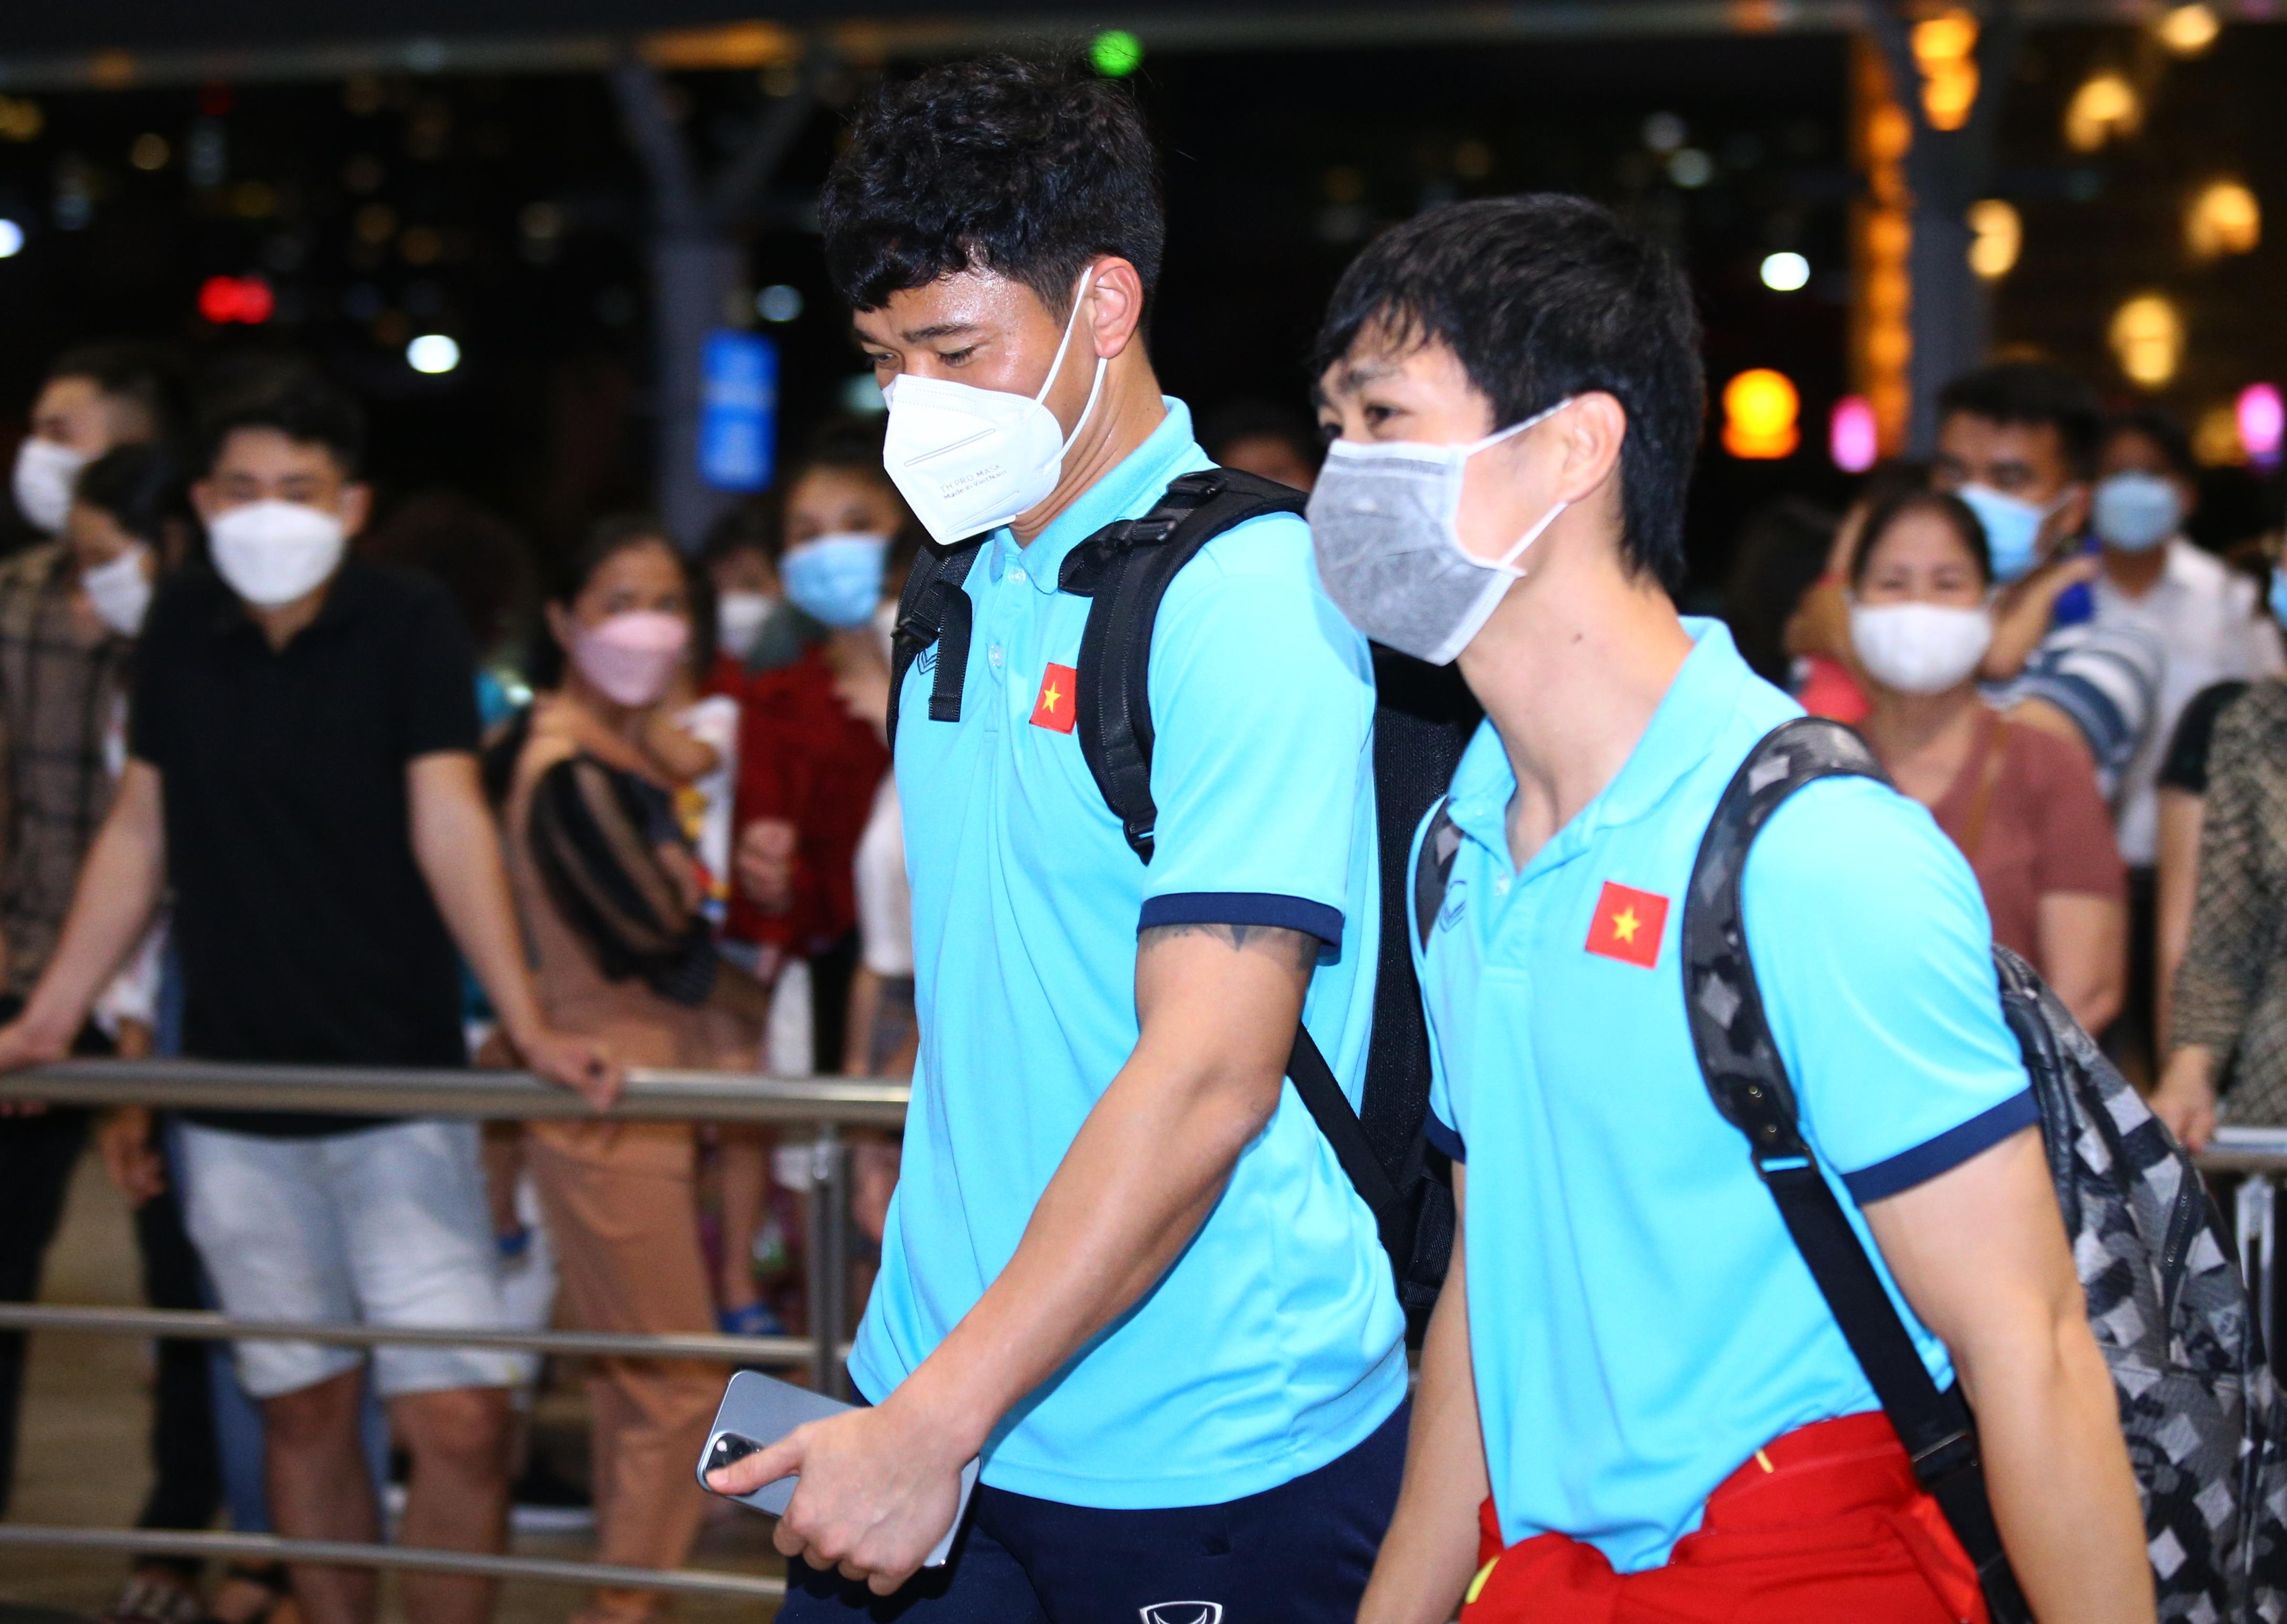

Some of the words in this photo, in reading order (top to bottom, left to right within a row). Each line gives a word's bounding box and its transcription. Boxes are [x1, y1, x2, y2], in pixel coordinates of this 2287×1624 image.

[954, 475, 974, 486] PRO
[976, 463, 1003, 477] MASK
[944, 489, 964, 500] Made
